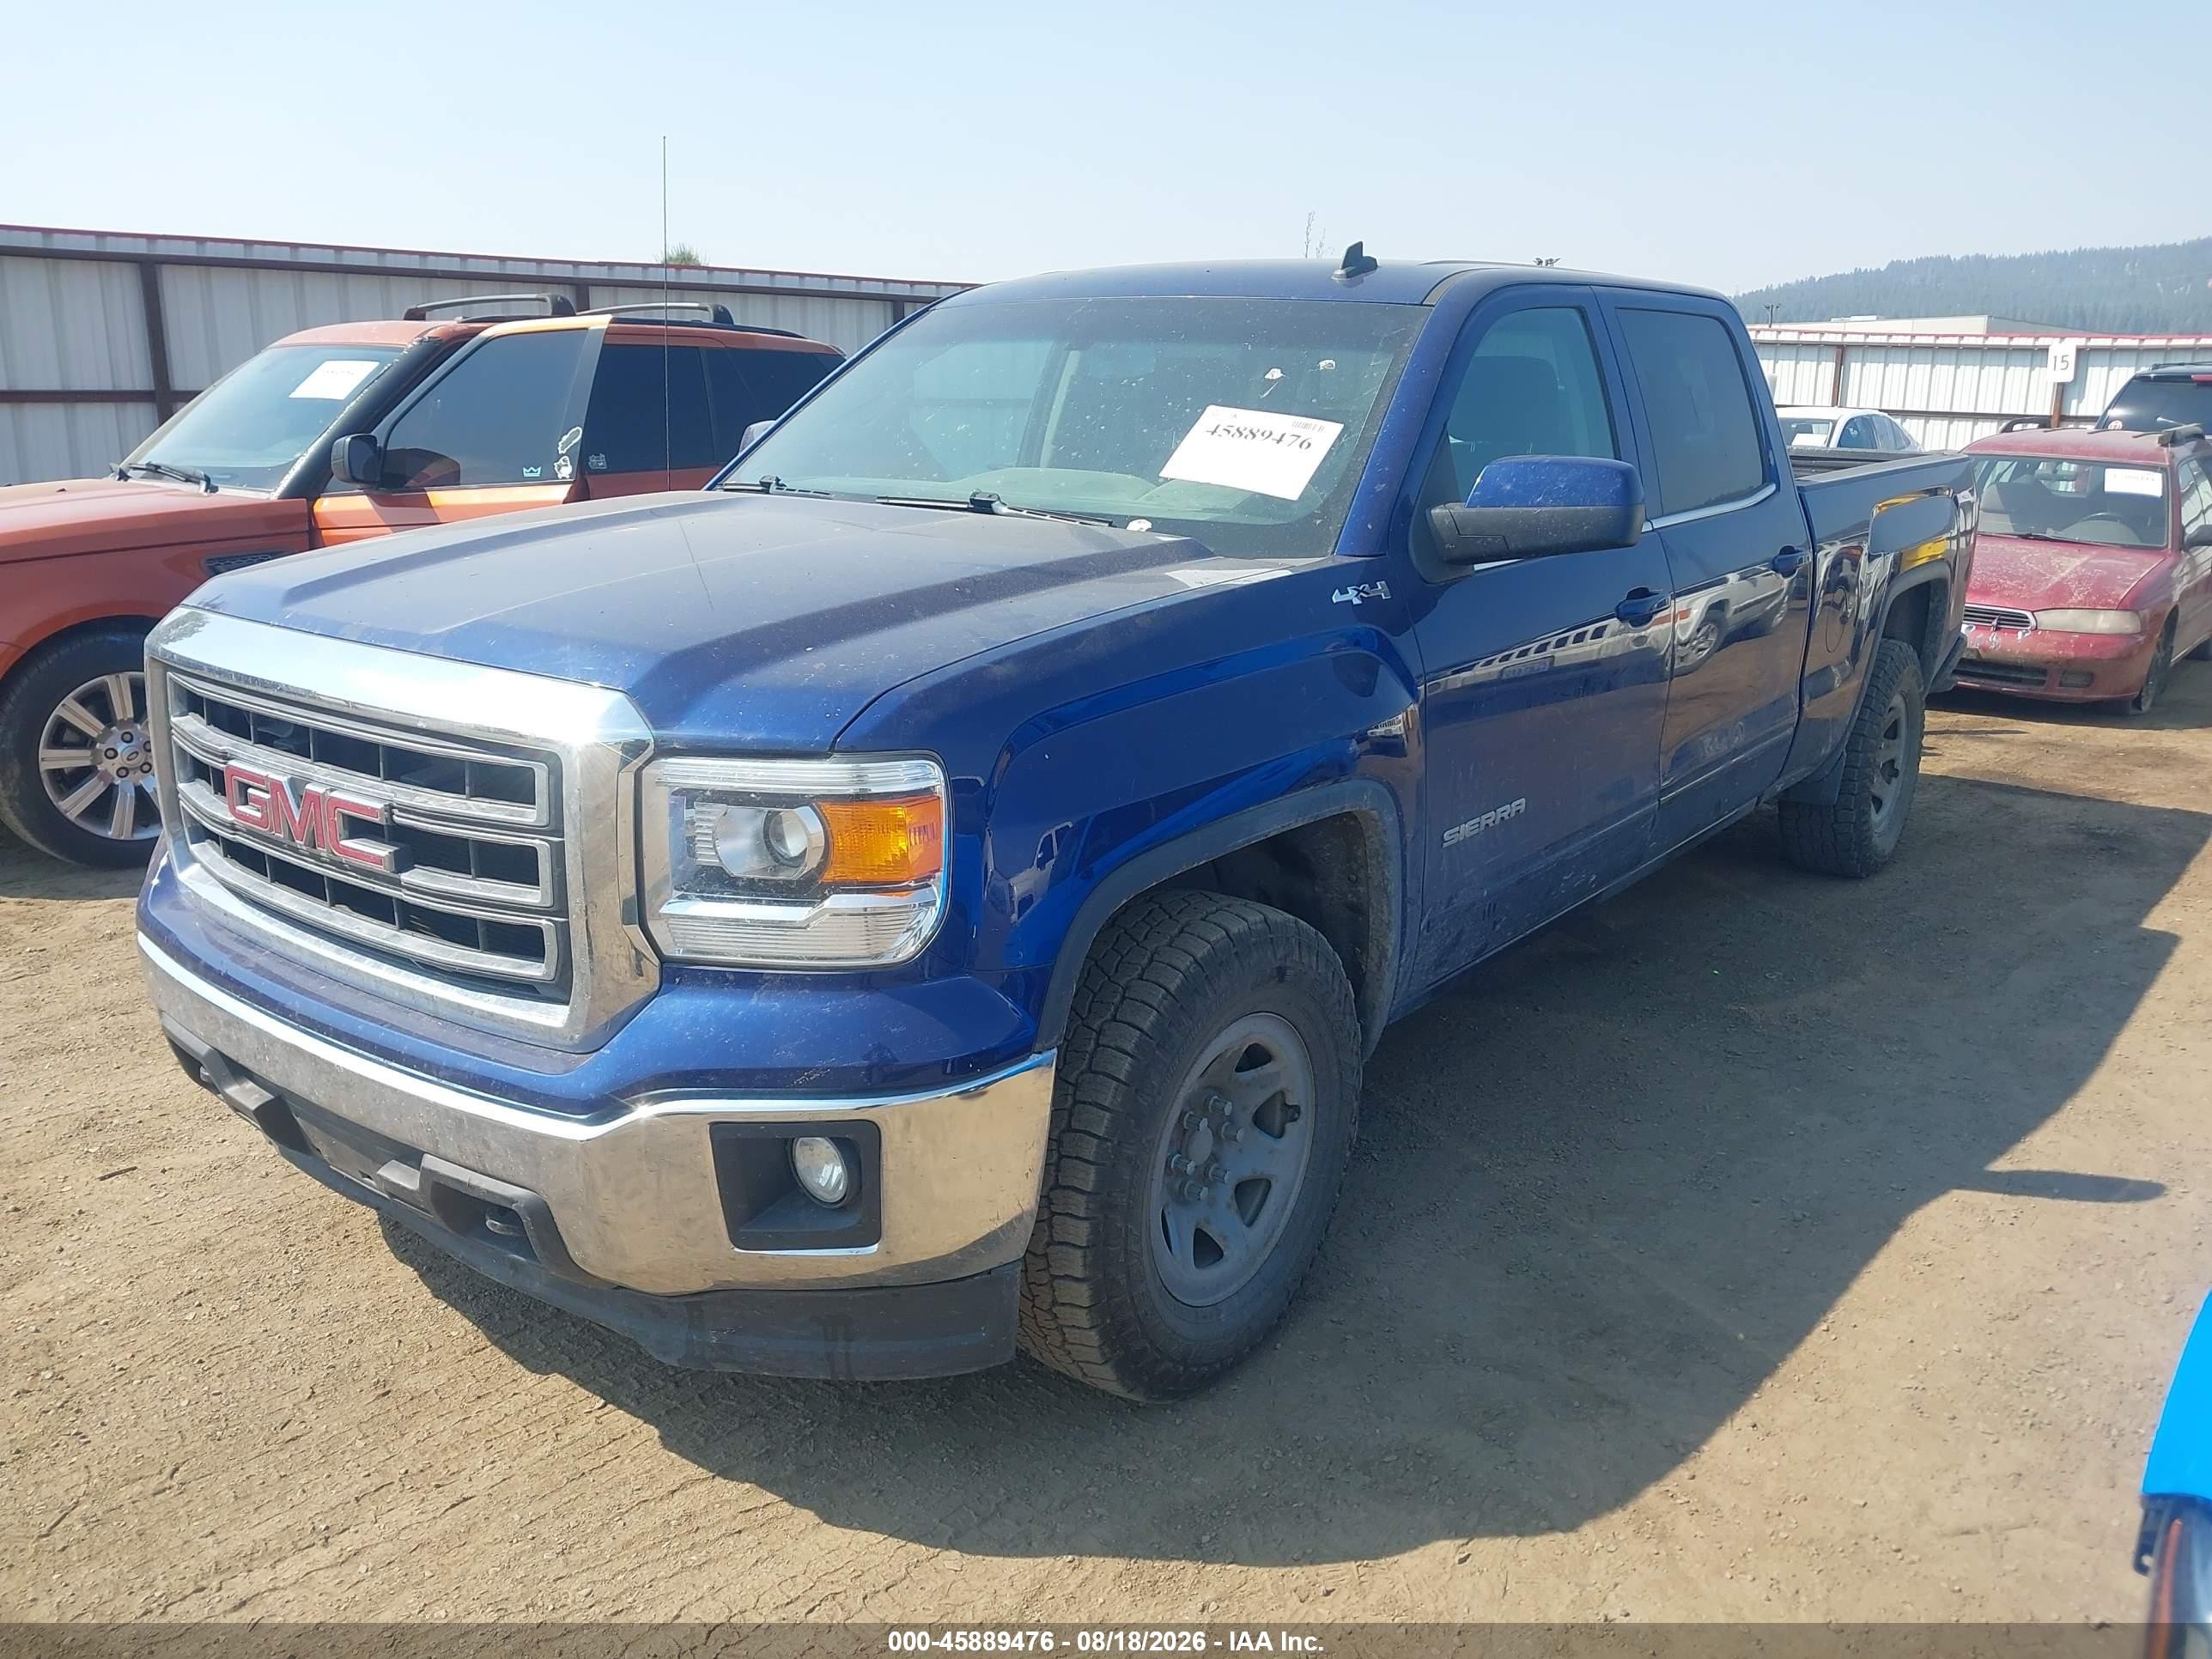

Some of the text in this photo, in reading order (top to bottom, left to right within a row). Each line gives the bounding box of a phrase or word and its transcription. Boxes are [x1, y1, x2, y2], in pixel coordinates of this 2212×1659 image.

[2053, 354, 2070, 372] 15
[1205, 422, 1313, 451] 45889476
[224, 760, 393, 872] GMC
[1443, 797, 1526, 849] SIERRA
